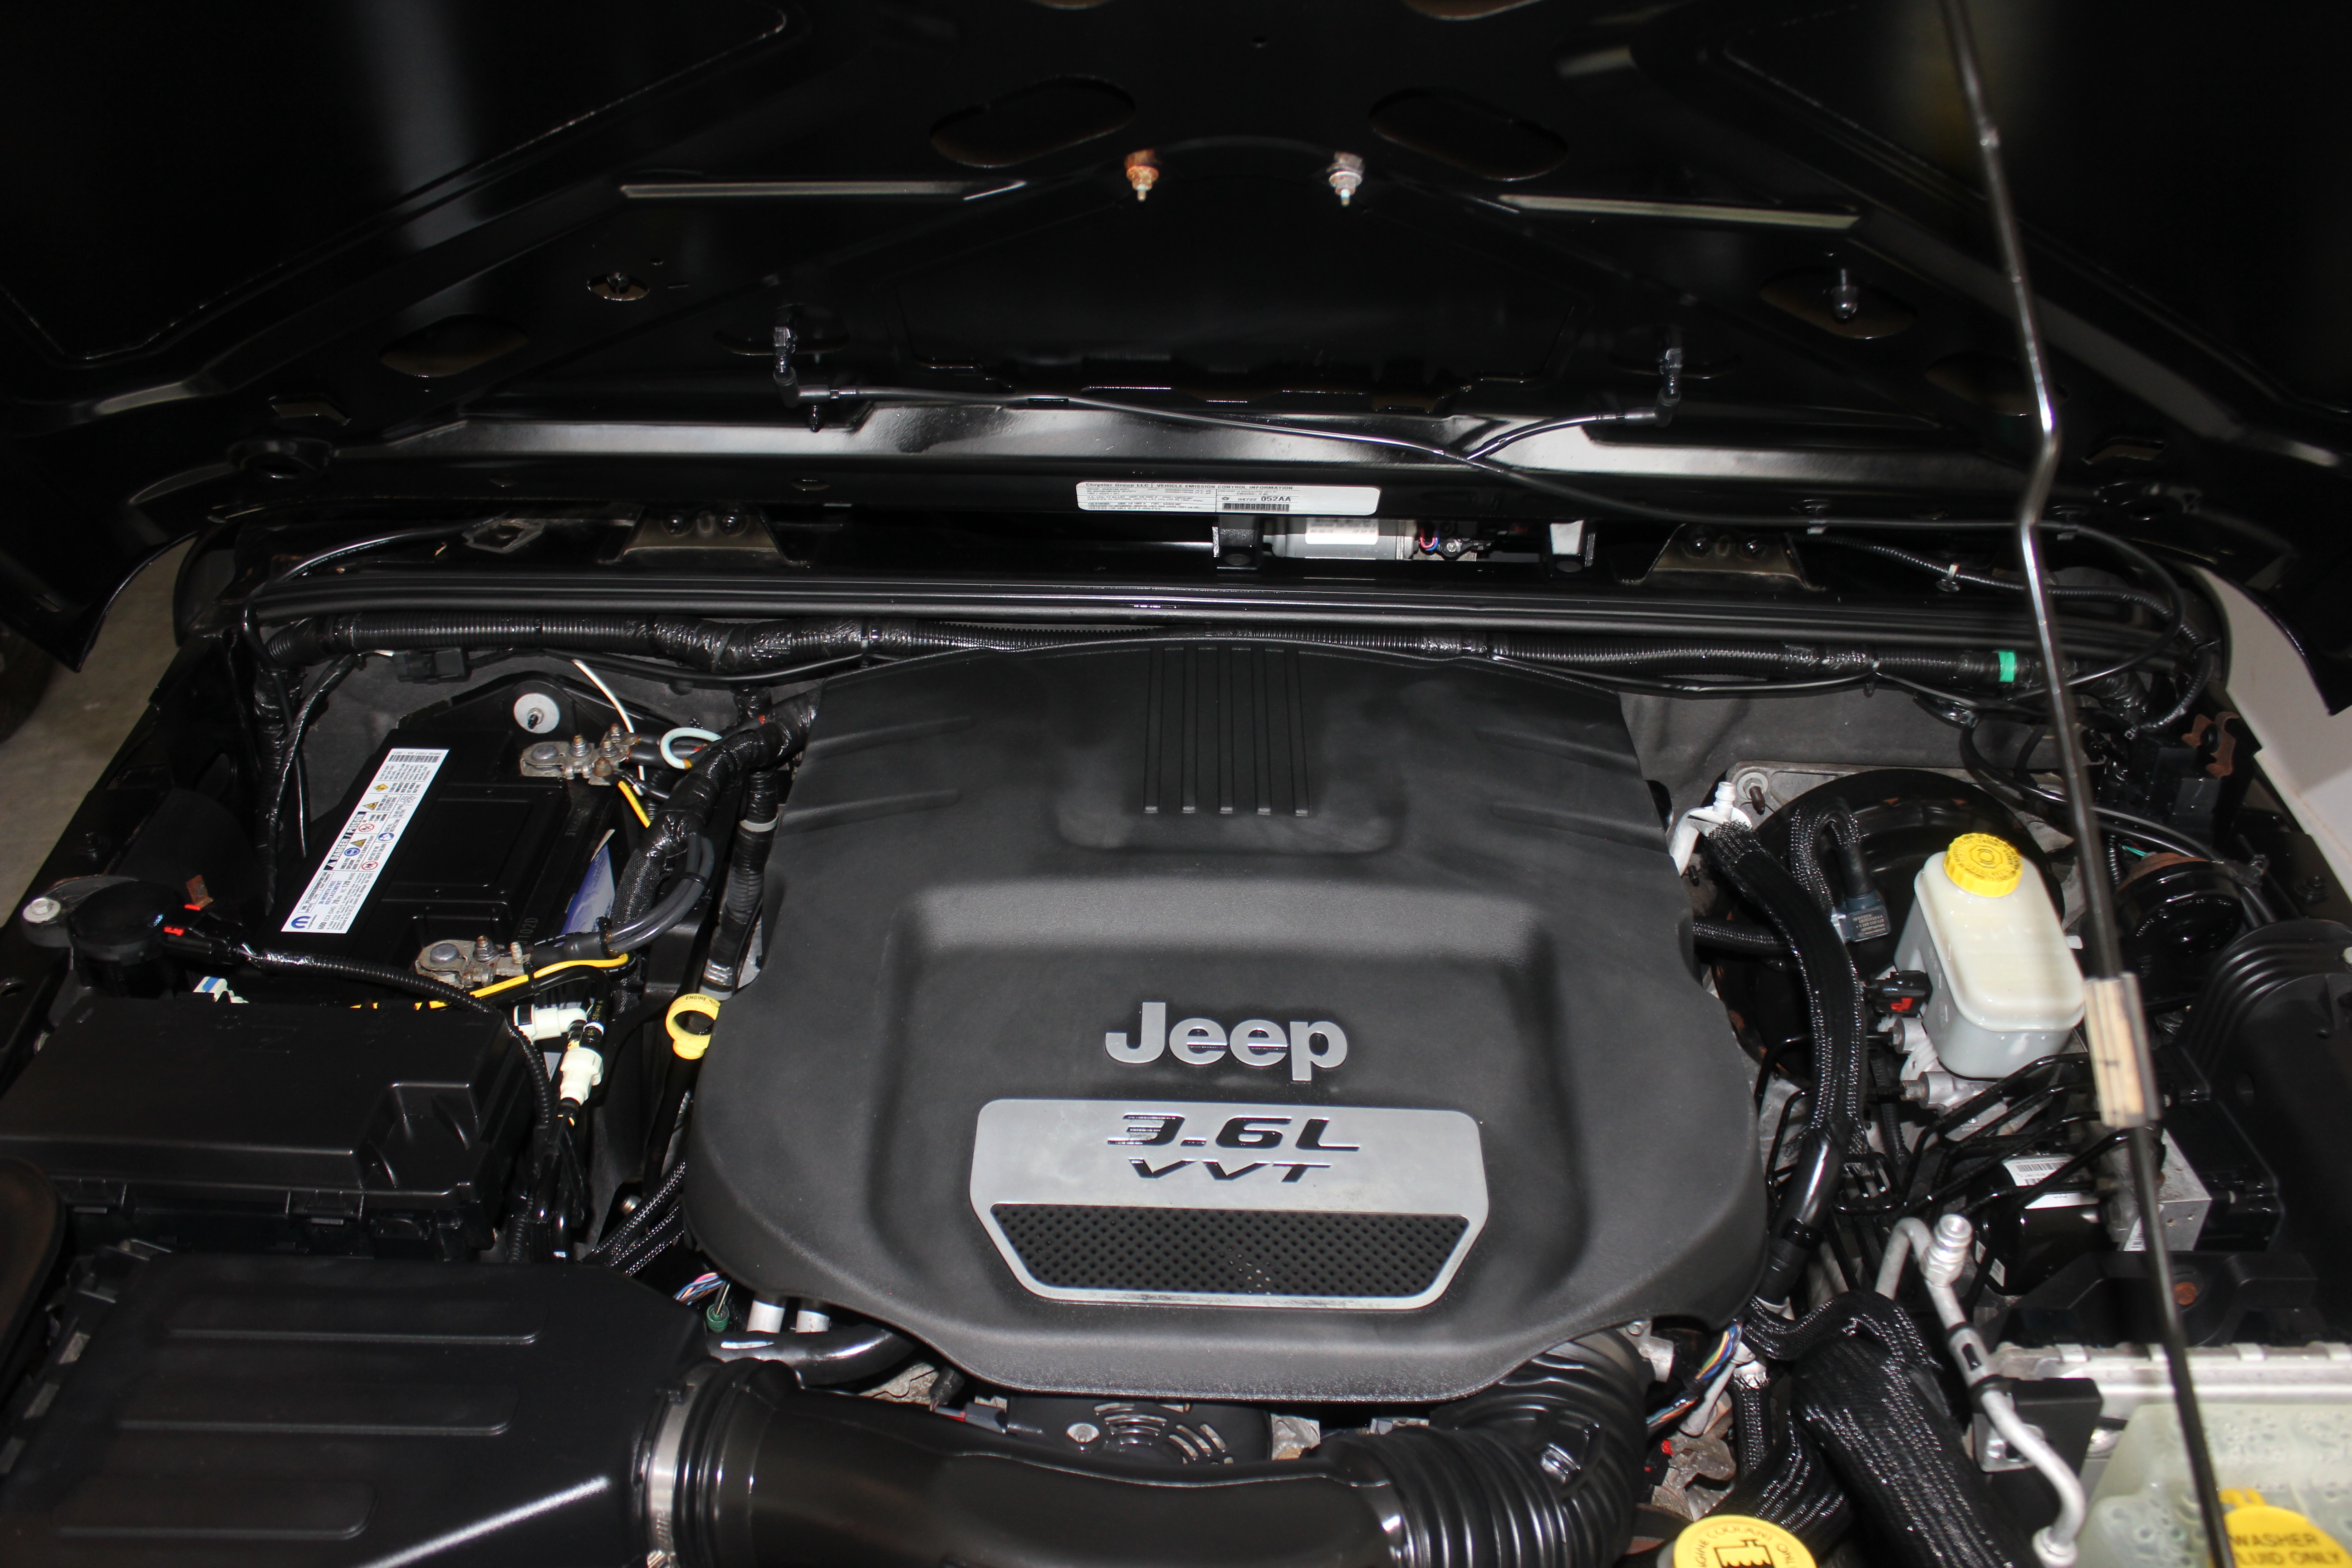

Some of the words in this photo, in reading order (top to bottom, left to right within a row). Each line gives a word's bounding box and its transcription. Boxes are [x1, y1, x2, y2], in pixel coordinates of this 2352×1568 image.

[332, 838, 349, 859] DANGER
[348, 814, 364, 833] POISON
[325, 880, 343, 904] REPLACEMENT
[1105, 1002, 1348, 1082] Jeep
[1107, 1112, 1360, 1152] 3.6L
[1127, 1158, 1332, 1183] VVT
[1694, 1539, 1710, 1568] GINE
[1707, 1526, 1774, 1543] COOLANT
[1777, 1544, 1797, 1568] ONL
[2228, 1532, 2319, 1548] WASHER
[2234, 1551, 2285, 1566] LUID
[2289, 1550, 2340, 1565] ONLY
